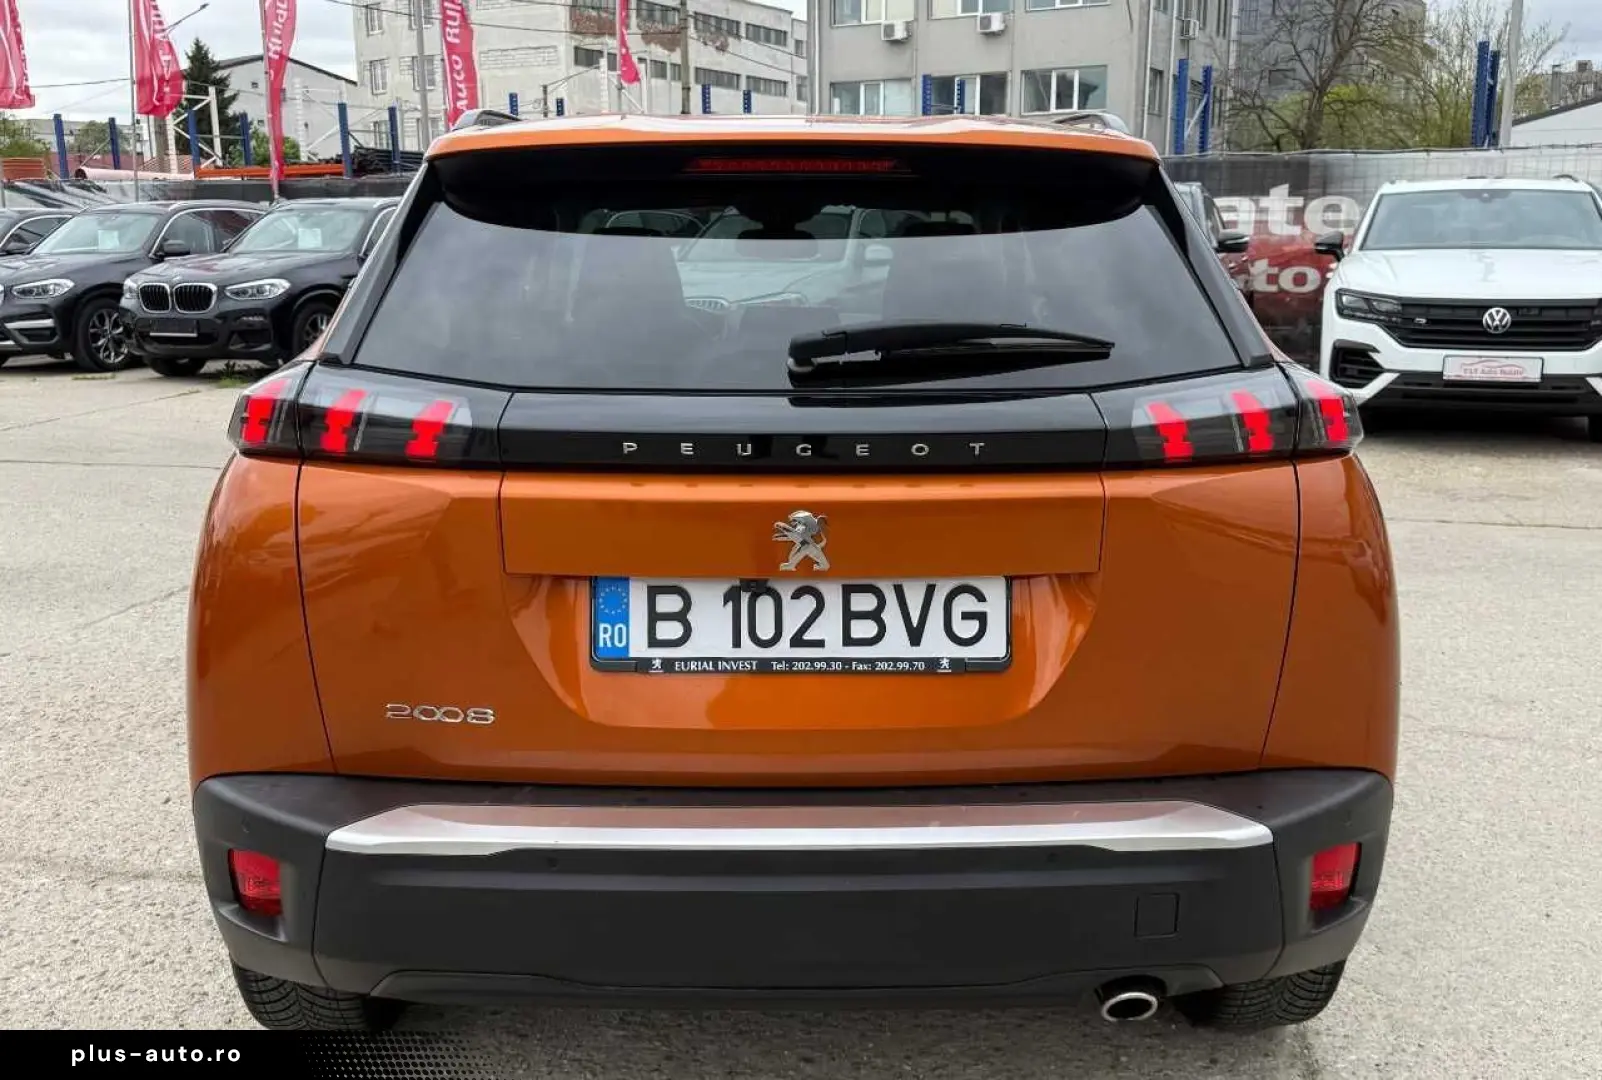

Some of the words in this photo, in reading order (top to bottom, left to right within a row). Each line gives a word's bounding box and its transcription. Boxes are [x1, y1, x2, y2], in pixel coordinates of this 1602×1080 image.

[622, 442, 985, 456] PEUGEOT
[647, 585, 692, 648] B
[722, 585, 826, 649] 102
[841, 584, 988, 648] BVG
[599, 623, 627, 648] RO
[675, 660, 715, 671] EURIAL
[718, 660, 758, 671] INVEST
[771, 661, 789, 671] Tel:
[792, 661, 842, 671] 202.99.30
[852, 661, 872, 671] Fax:
[875, 661, 925, 671] 202.99.70
[385, 703, 495, 724] 2008
